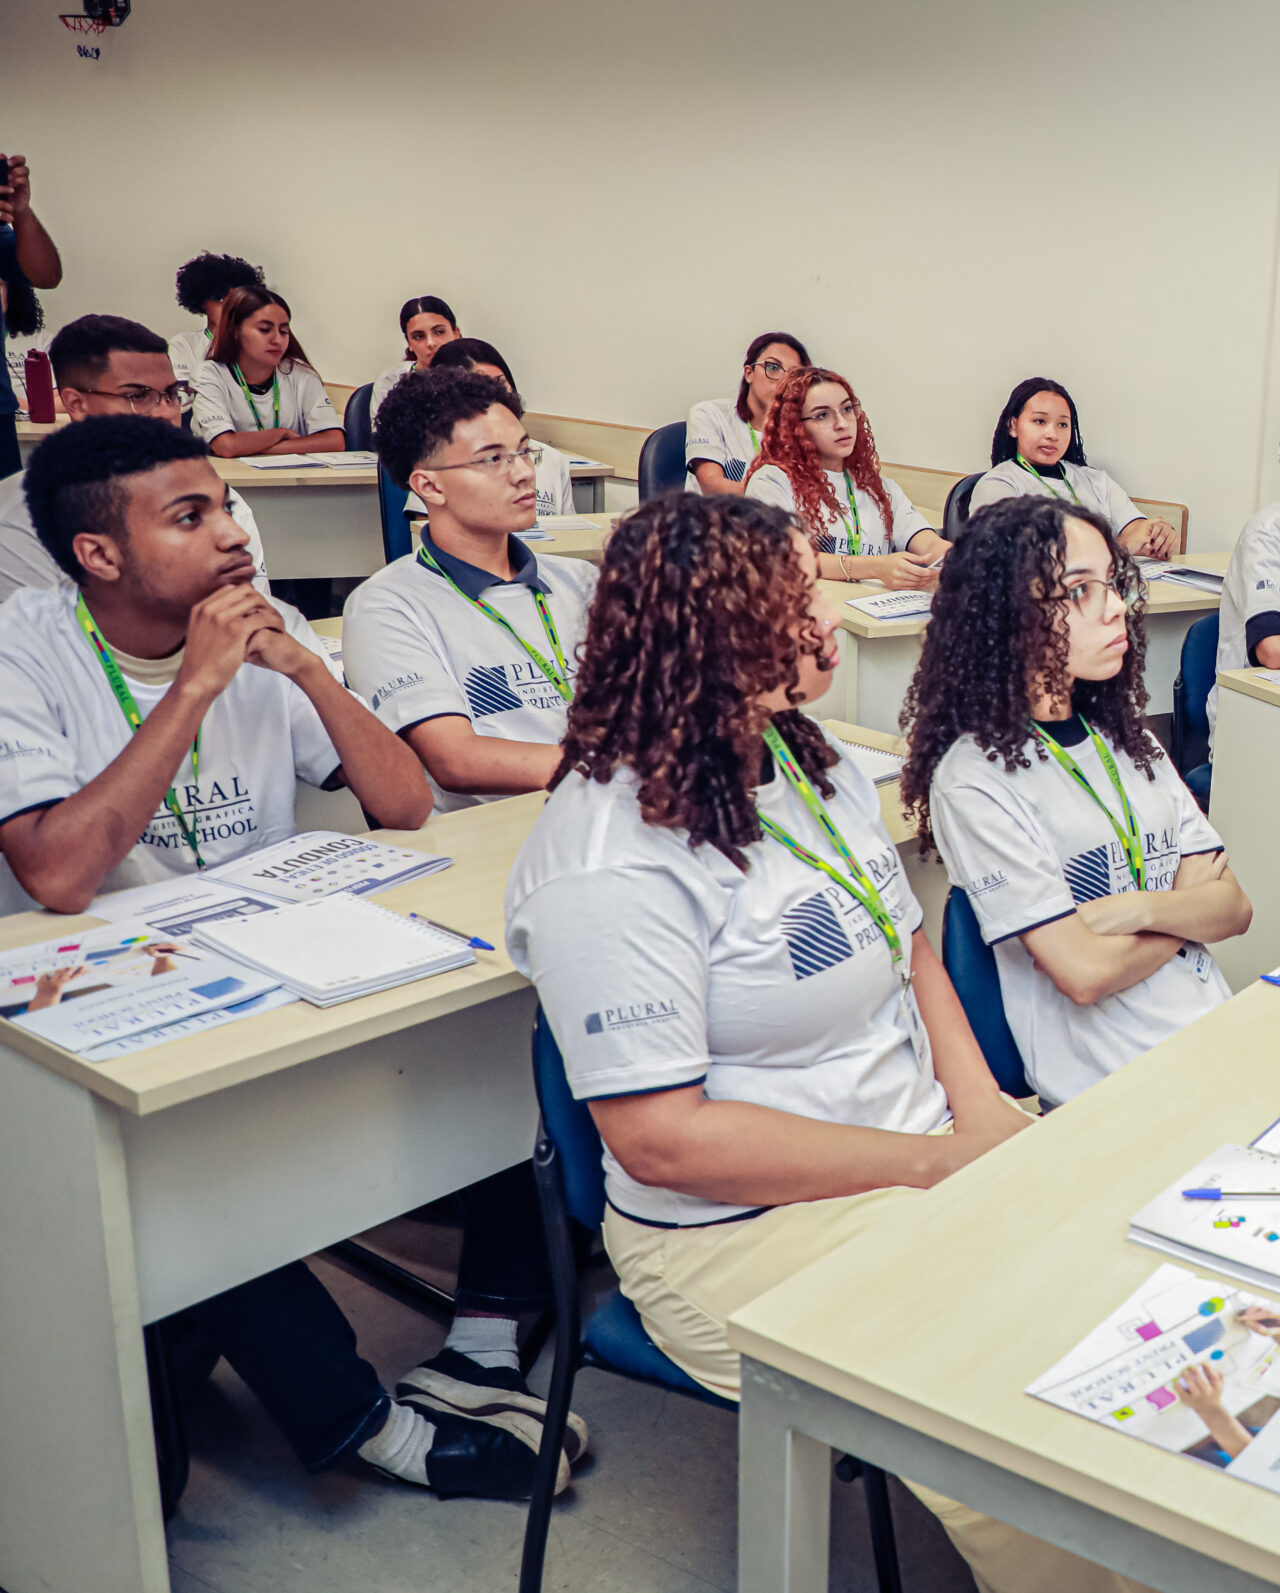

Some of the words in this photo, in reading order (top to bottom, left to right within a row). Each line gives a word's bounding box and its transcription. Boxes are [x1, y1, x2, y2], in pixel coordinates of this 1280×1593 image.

[378, 672, 424, 698] PLURAL
[251, 838, 364, 879] CONDUTA
[605, 1000, 679, 1022] PLURAL
